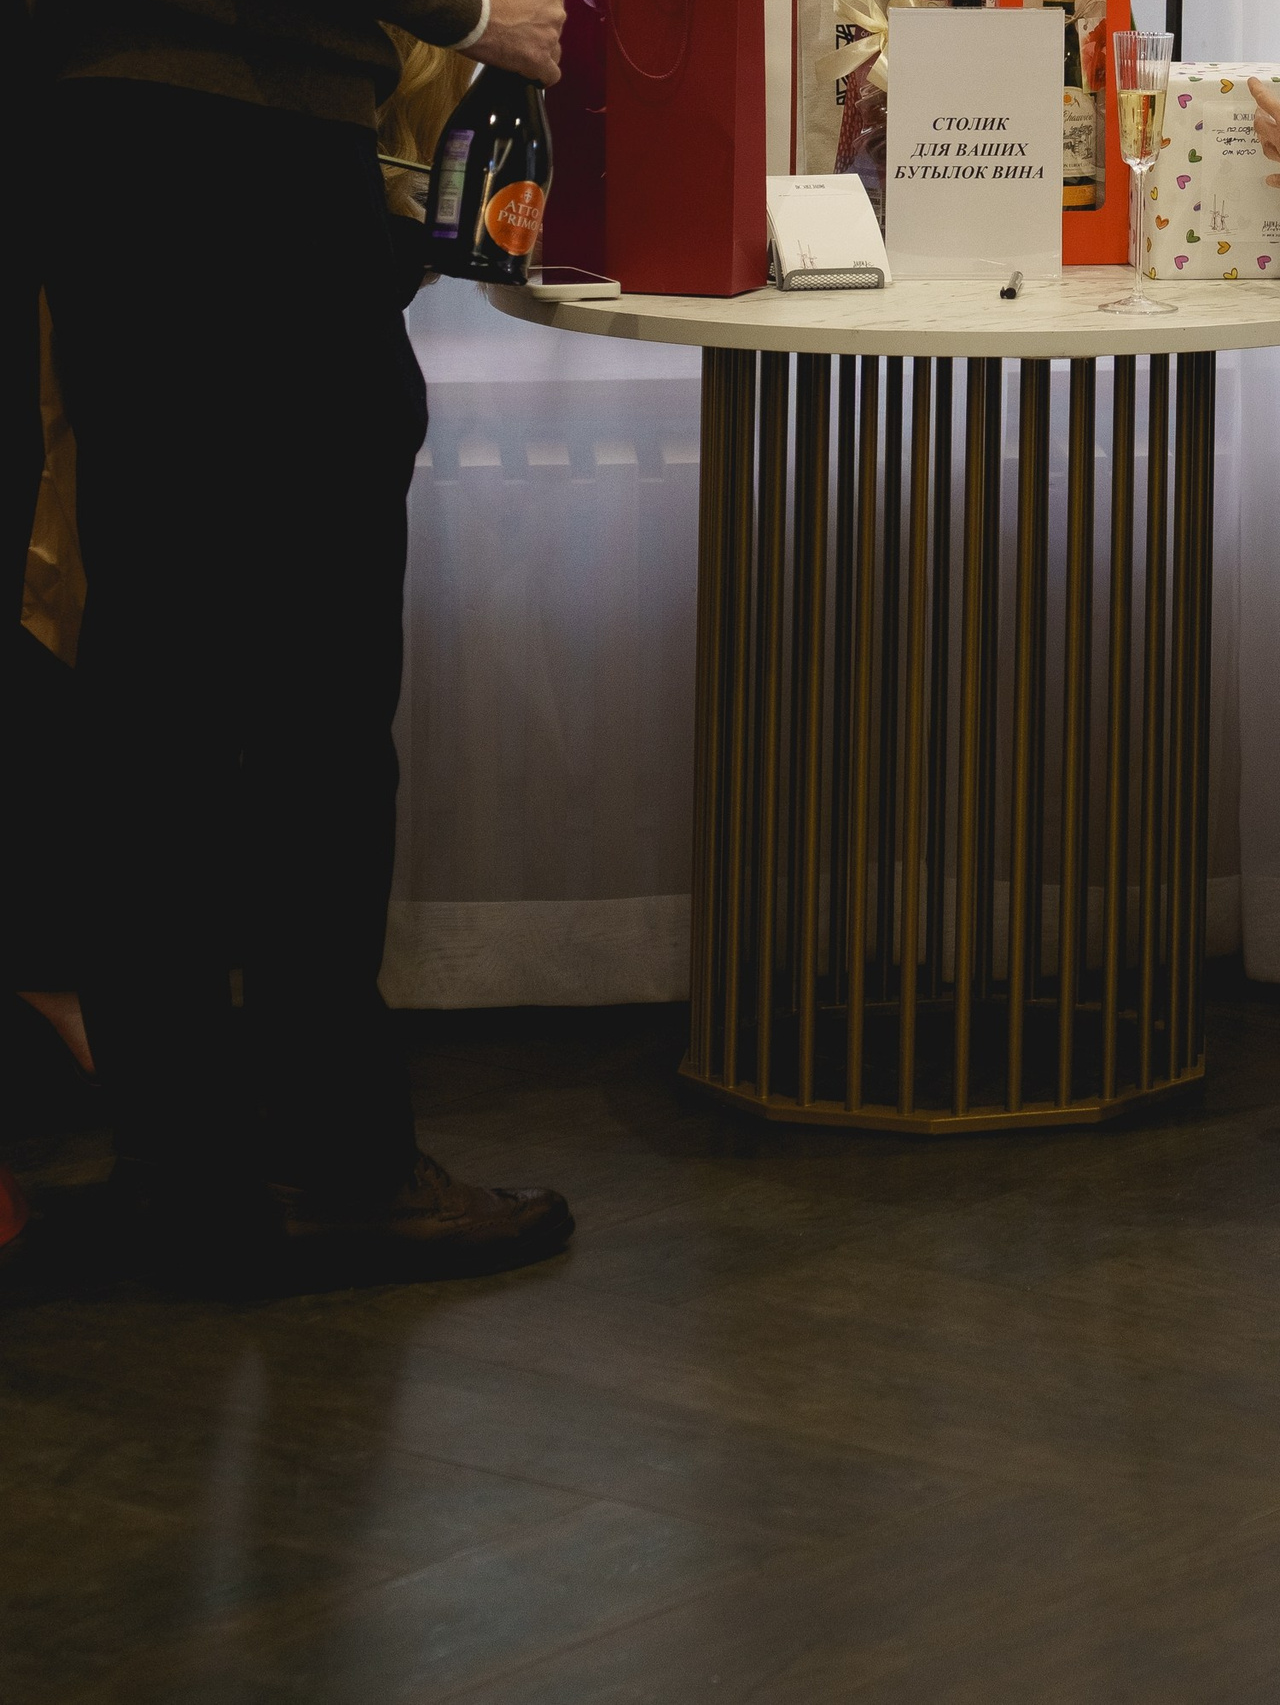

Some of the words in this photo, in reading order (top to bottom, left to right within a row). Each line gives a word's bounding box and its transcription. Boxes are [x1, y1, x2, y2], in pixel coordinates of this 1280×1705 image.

[932, 117, 1010, 131] СТОЛИК
[910, 143, 951, 160] ДЛЯ
[954, 143, 1029, 157] ВАШИХ
[894, 165, 989, 180] БУТЫЛОК
[991, 165, 1045, 180] ВИНА
[504, 199, 539, 219] ATTO
[496, 209, 538, 231] PRIMO
